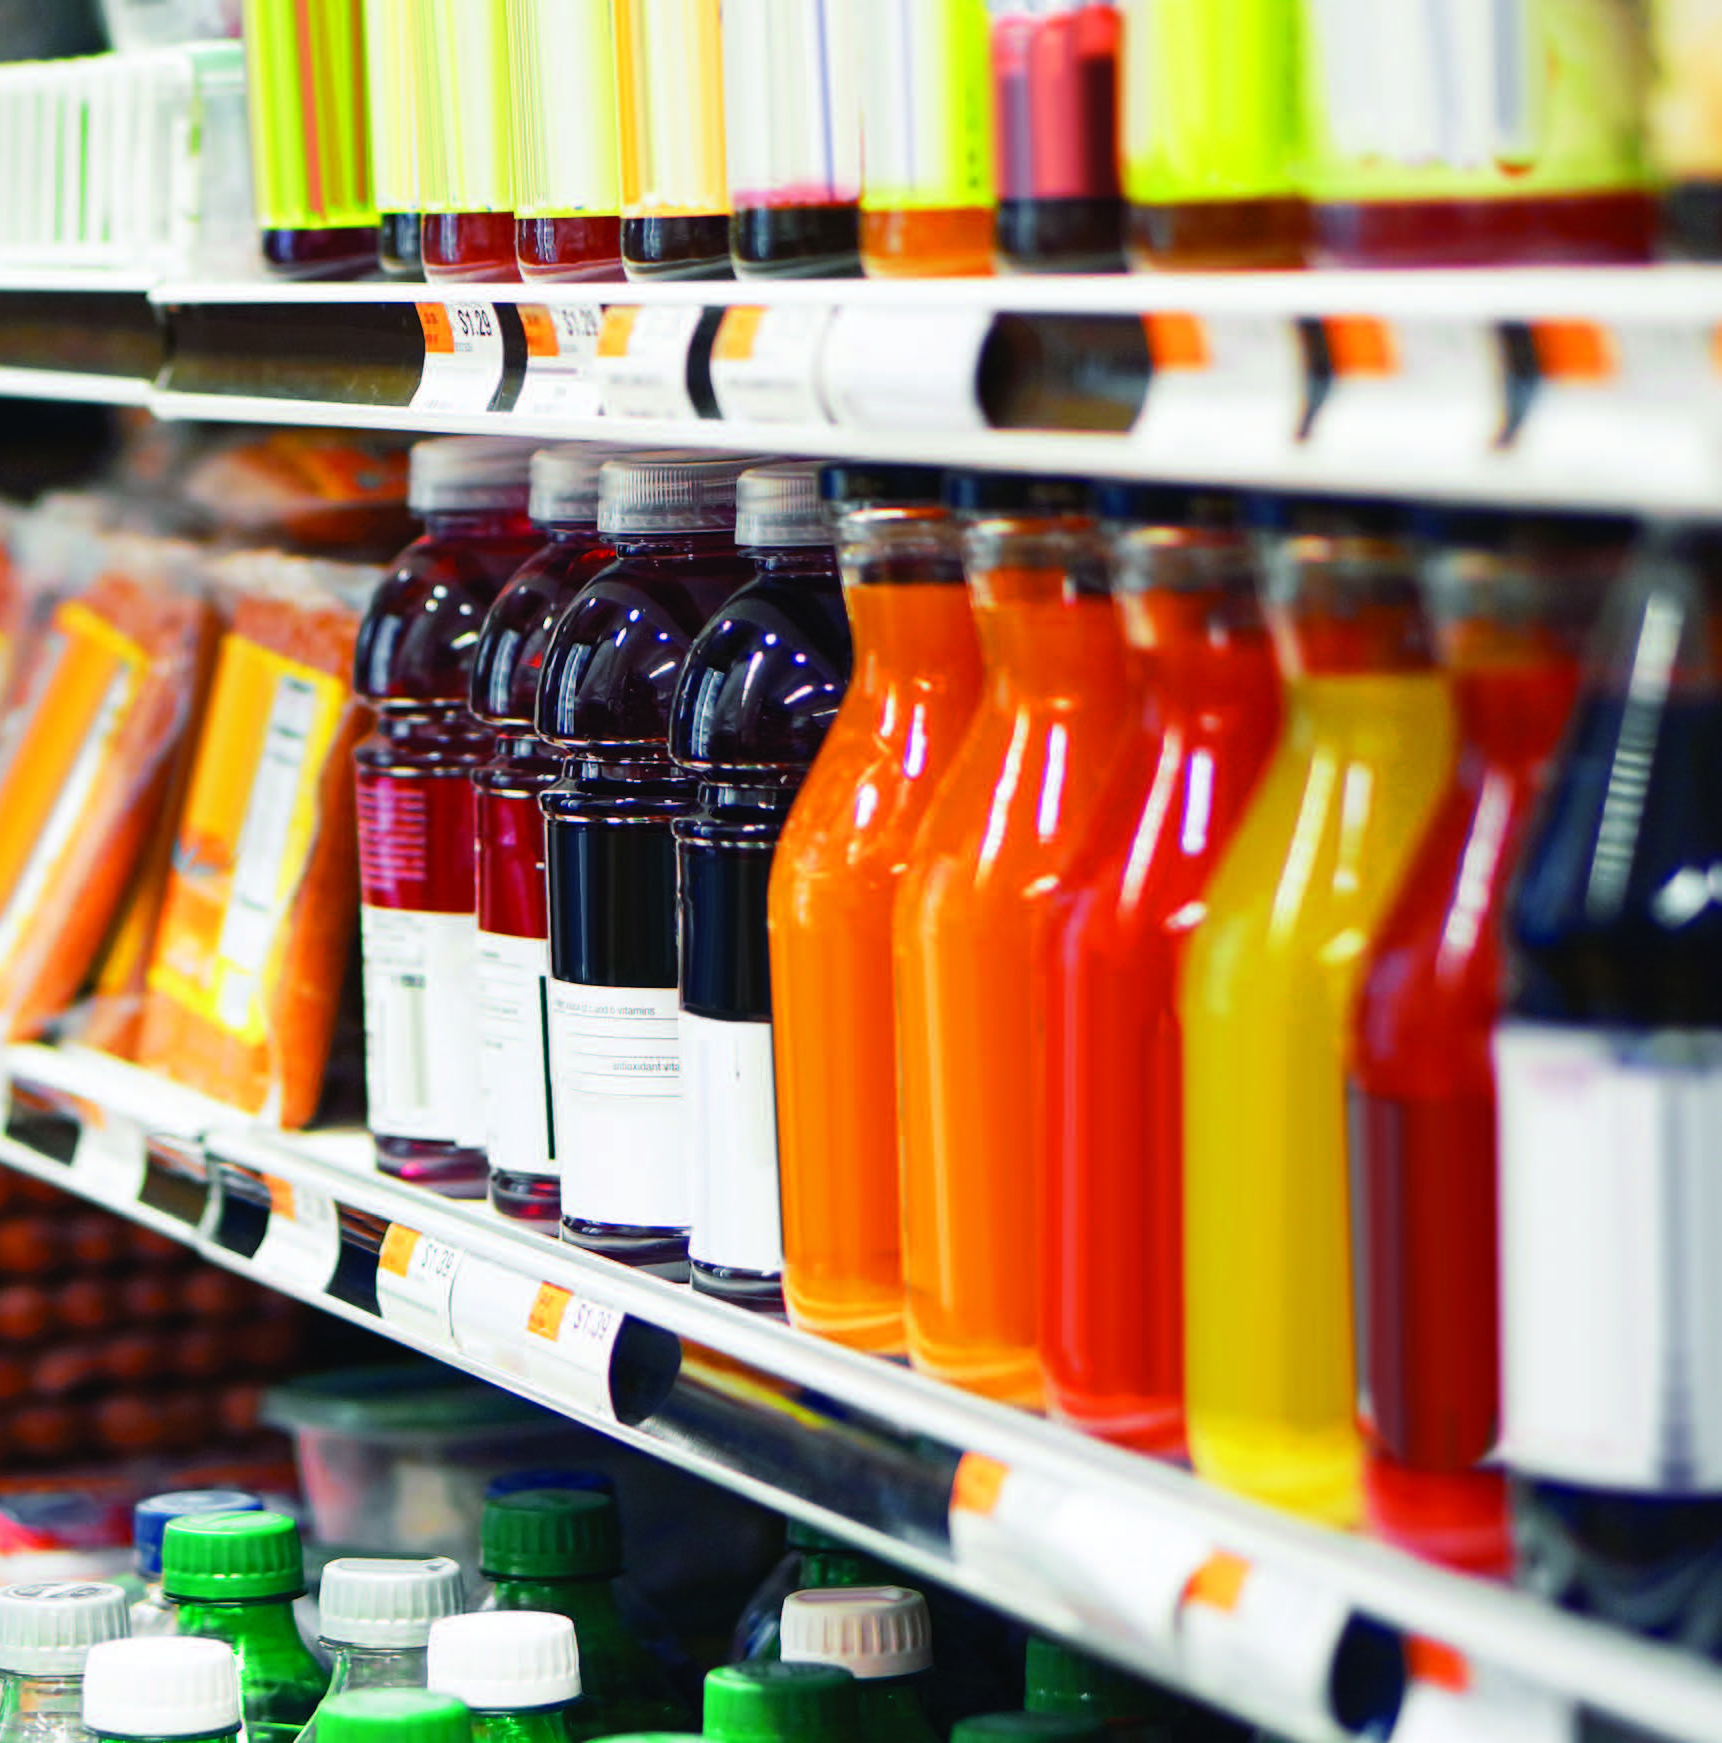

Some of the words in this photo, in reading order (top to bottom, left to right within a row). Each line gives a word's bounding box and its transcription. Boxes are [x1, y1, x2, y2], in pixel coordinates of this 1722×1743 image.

[457, 309, 493, 336] $1.29
[561, 309, 599, 336] $1.29
[618, 1004, 656, 1016] vitamins
[612, 1061, 661, 1071] antioxidant
[421, 1243, 455, 1277] $1.39
[573, 1303, 612, 1340] $1.39
